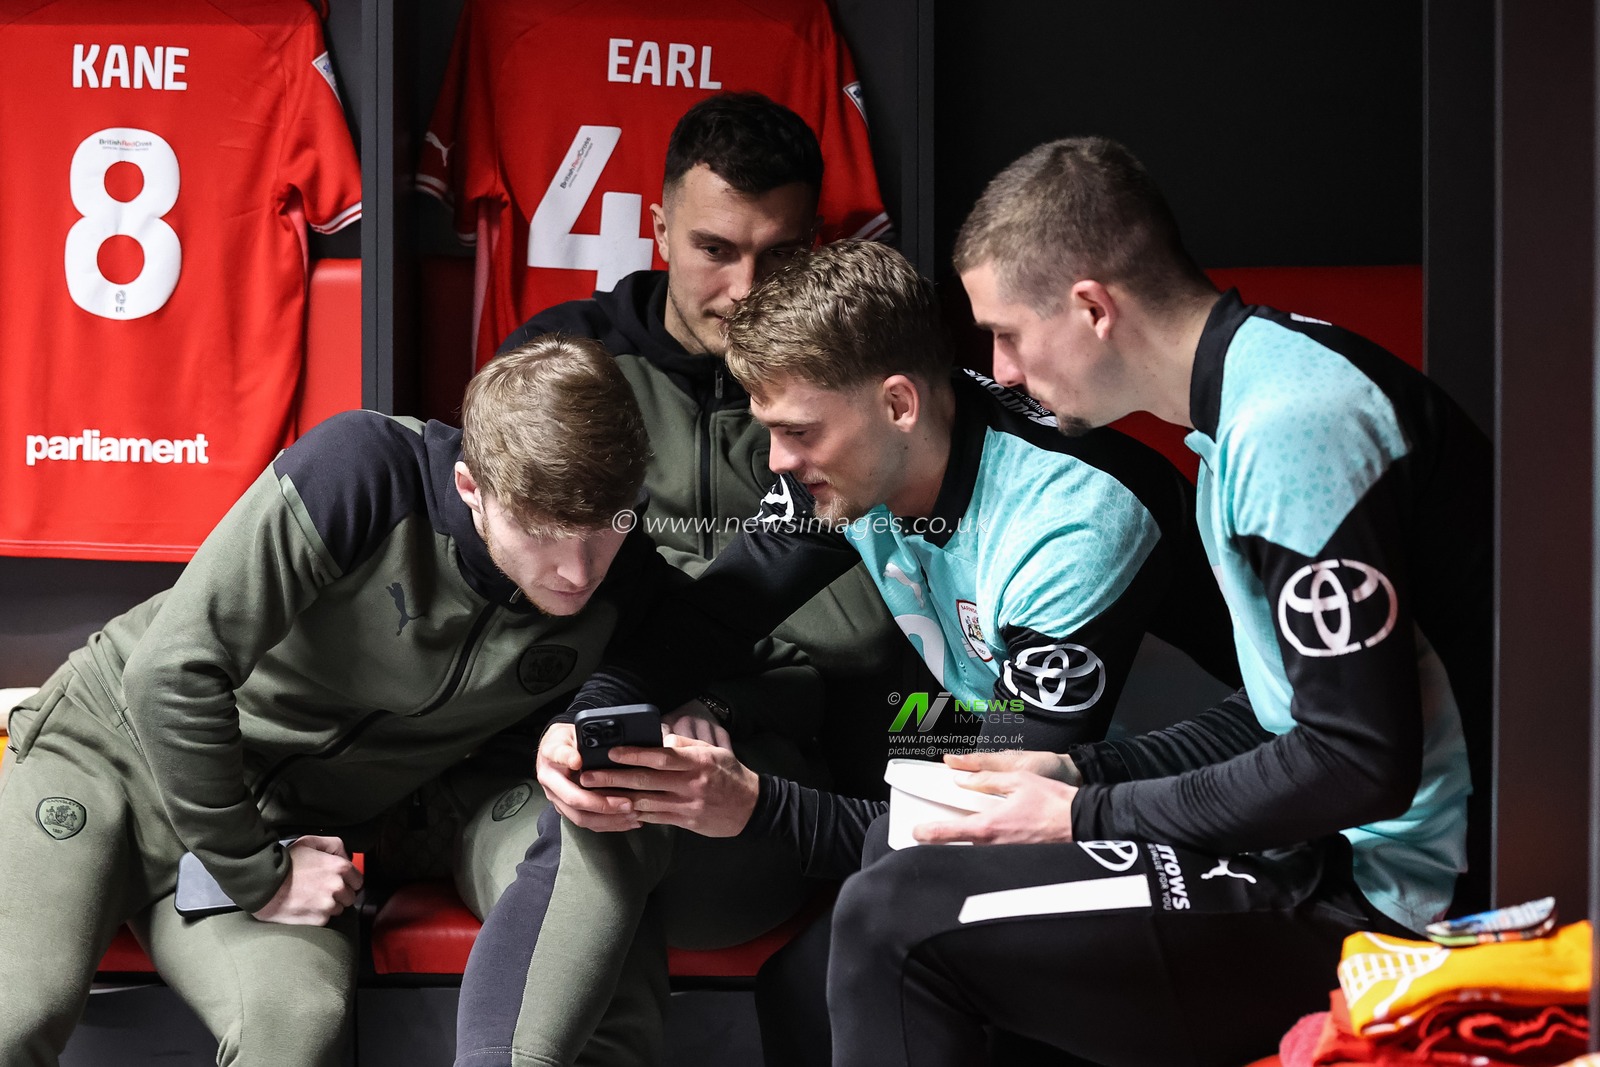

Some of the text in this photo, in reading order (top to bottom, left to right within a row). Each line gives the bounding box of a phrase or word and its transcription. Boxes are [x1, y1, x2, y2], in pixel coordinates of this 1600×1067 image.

[72, 44, 190, 91] KANE
[608, 38, 722, 90] EARL
[64, 127, 182, 320] 8
[528, 125, 654, 293] 4
[26, 430, 209, 466] parliament
[1155, 844, 1191, 910] rrows
[1162, 890, 1173, 911] YOU
